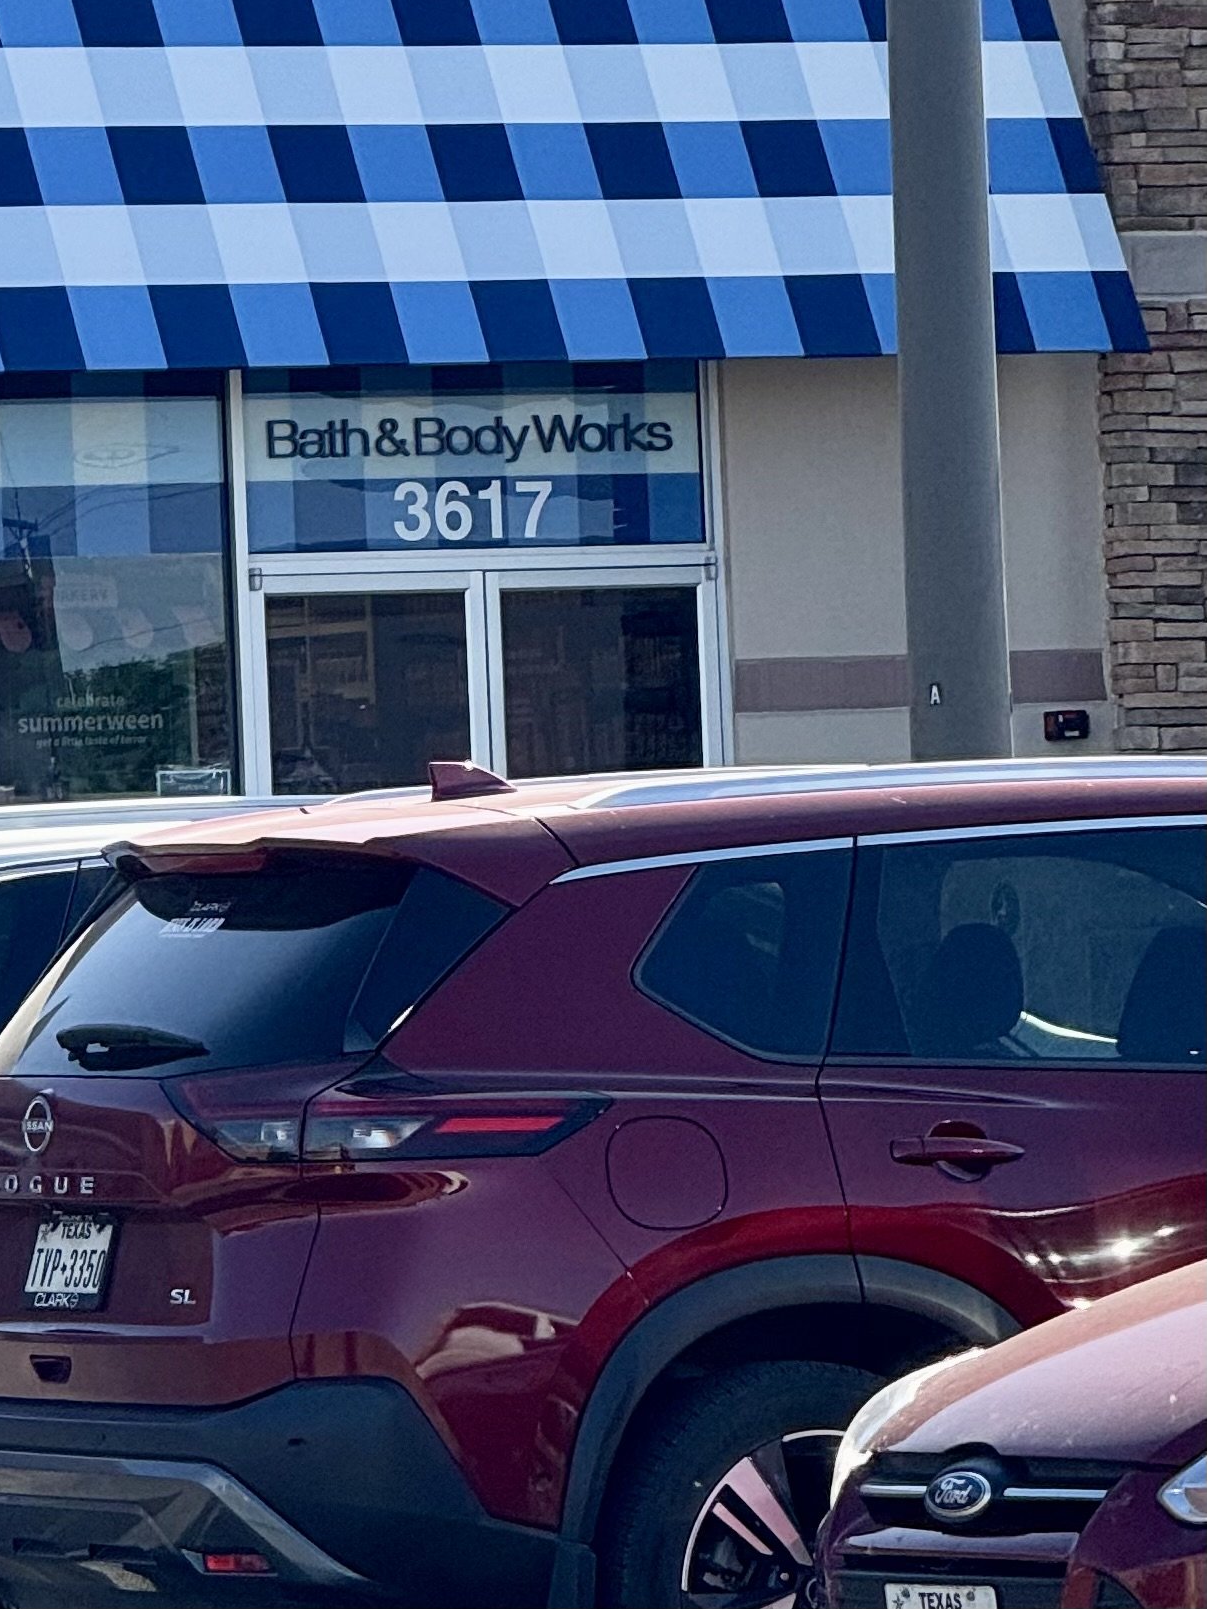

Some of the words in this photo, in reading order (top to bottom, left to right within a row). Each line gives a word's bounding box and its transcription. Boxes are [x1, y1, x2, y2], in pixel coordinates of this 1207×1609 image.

[266, 418, 370, 459] Bath
[414, 416, 529, 463] Body
[532, 413, 673, 453] Works
[393, 479, 552, 542] 3617
[57, 693, 126, 708] celebrate
[930, 684, 941, 705] A
[17, 713, 164, 734] summerween
[61, 1223, 92, 1240] TEXAS
[34, 1293, 71, 1308] CLARK
[170, 1288, 197, 1306] SL
[934, 1477, 973, 1505] Ford
[918, 1592, 963, 1609] TEXAS
